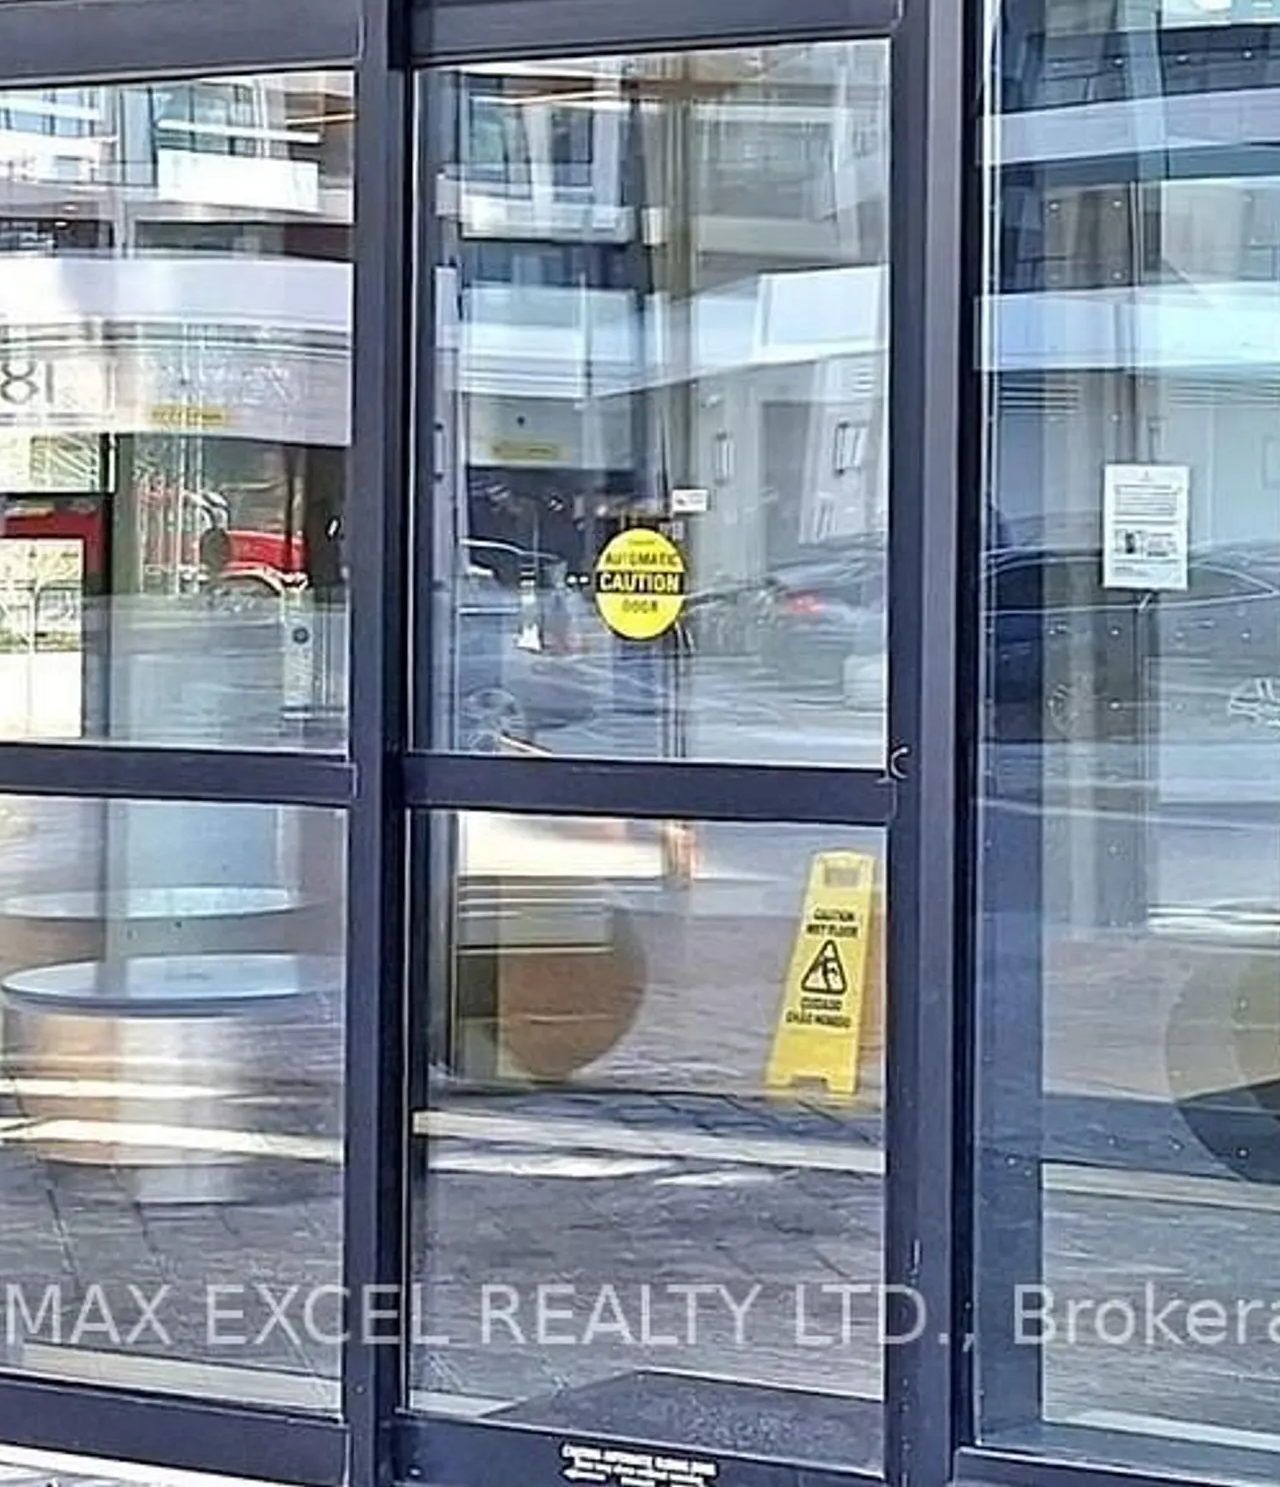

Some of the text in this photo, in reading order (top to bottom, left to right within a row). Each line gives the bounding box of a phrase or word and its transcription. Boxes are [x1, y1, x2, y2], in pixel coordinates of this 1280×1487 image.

[604, 550, 681, 567] AUTOMATIC
[600, 571, 681, 593] CAUTION
[622, 597, 659, 615] DOOR
